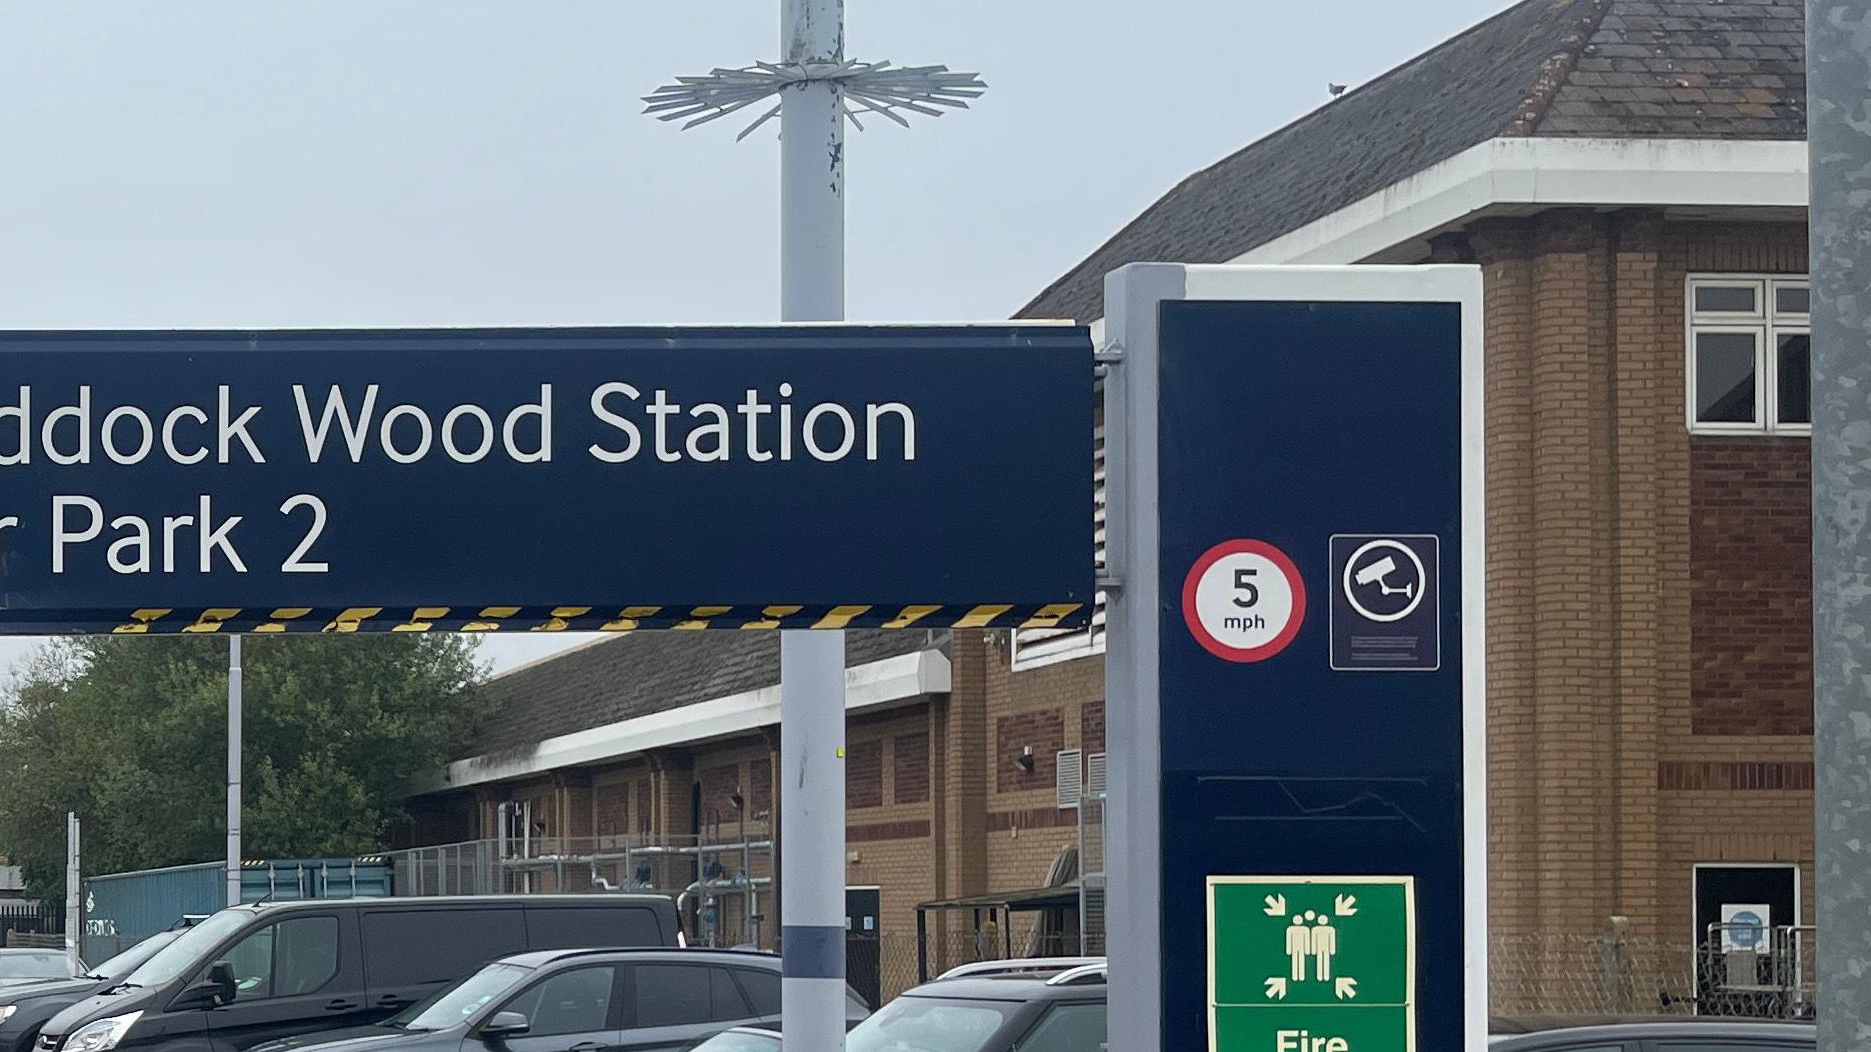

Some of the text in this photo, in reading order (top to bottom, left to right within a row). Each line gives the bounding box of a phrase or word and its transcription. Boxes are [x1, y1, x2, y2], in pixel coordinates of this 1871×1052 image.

[292, 383, 552, 464] Wood
[588, 381, 916, 463] Station
[52, 495, 248, 574] Park
[279, 494, 329, 573] 2
[1232, 568, 1259, 609] 5
[1224, 614, 1265, 632] mph
